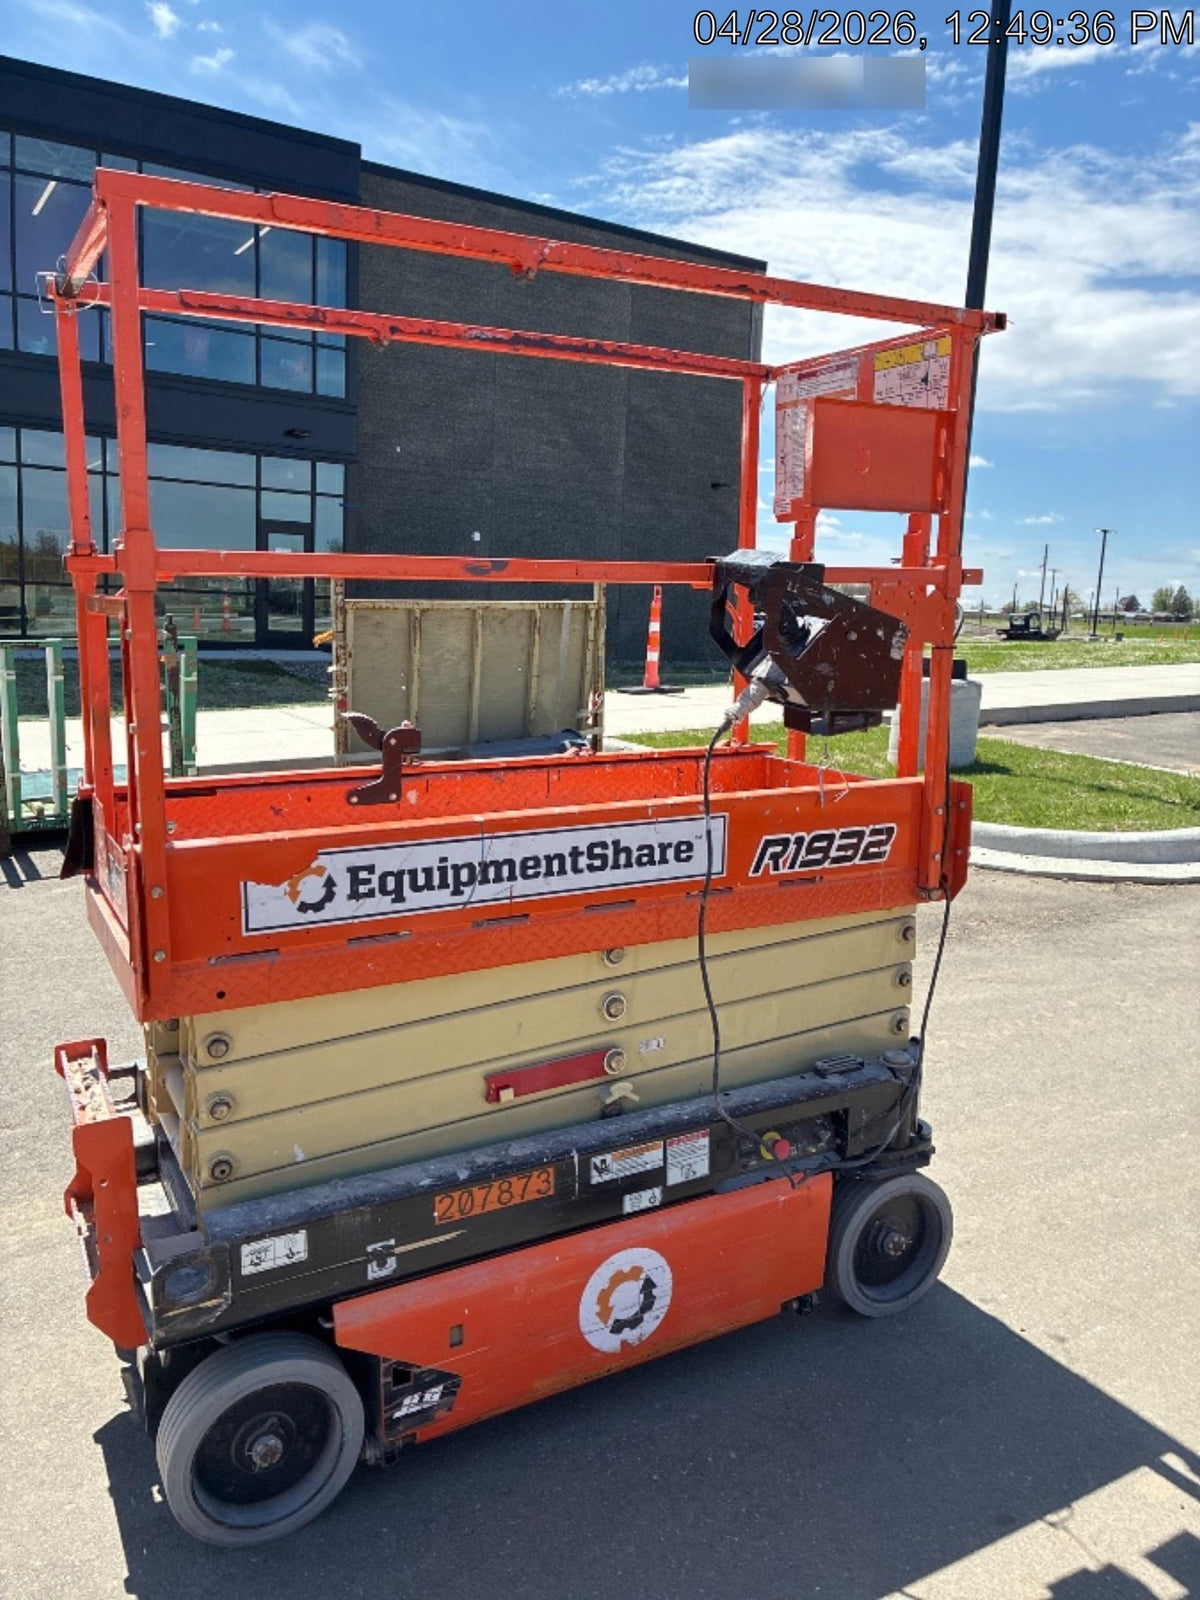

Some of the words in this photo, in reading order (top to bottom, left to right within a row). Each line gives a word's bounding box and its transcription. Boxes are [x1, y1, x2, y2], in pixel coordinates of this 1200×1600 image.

[346, 838, 694, 903] EquipmentShare
[748, 823, 897, 876] R1932
[437, 1169, 554, 1222] 207873
